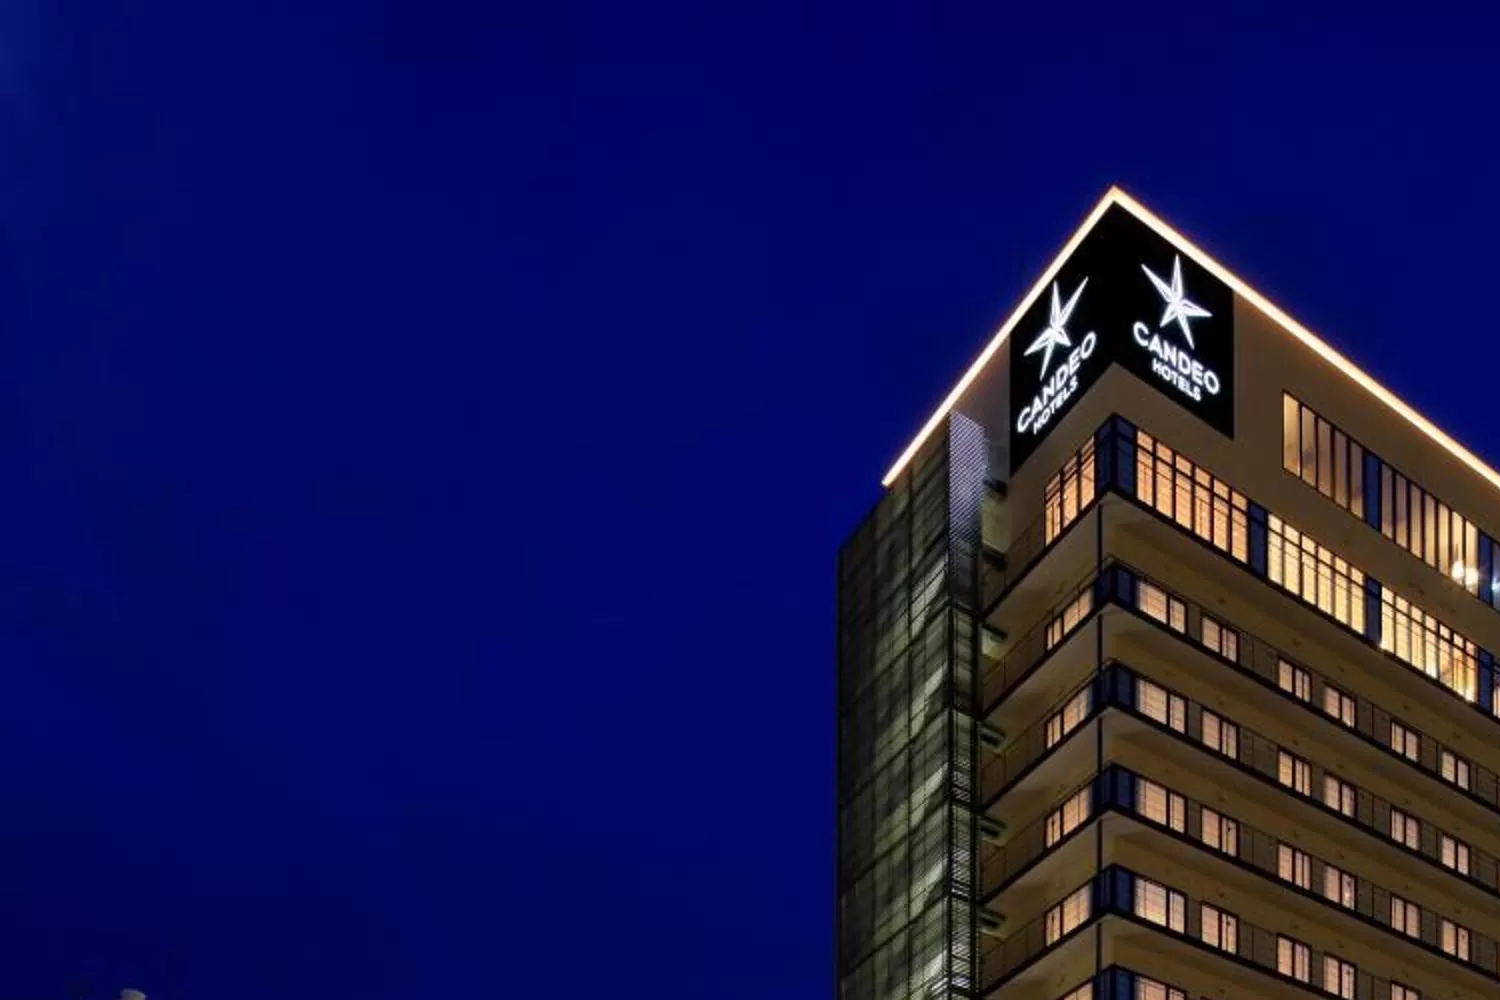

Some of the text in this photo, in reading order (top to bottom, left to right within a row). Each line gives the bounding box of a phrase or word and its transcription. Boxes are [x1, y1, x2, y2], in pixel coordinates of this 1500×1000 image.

[1016, 331, 1097, 433] CANDEO
[1132, 320, 1221, 395] CANDEO
[1152, 357, 1202, 402] HOTELS
[1033, 375, 1078, 436] HOTELS
